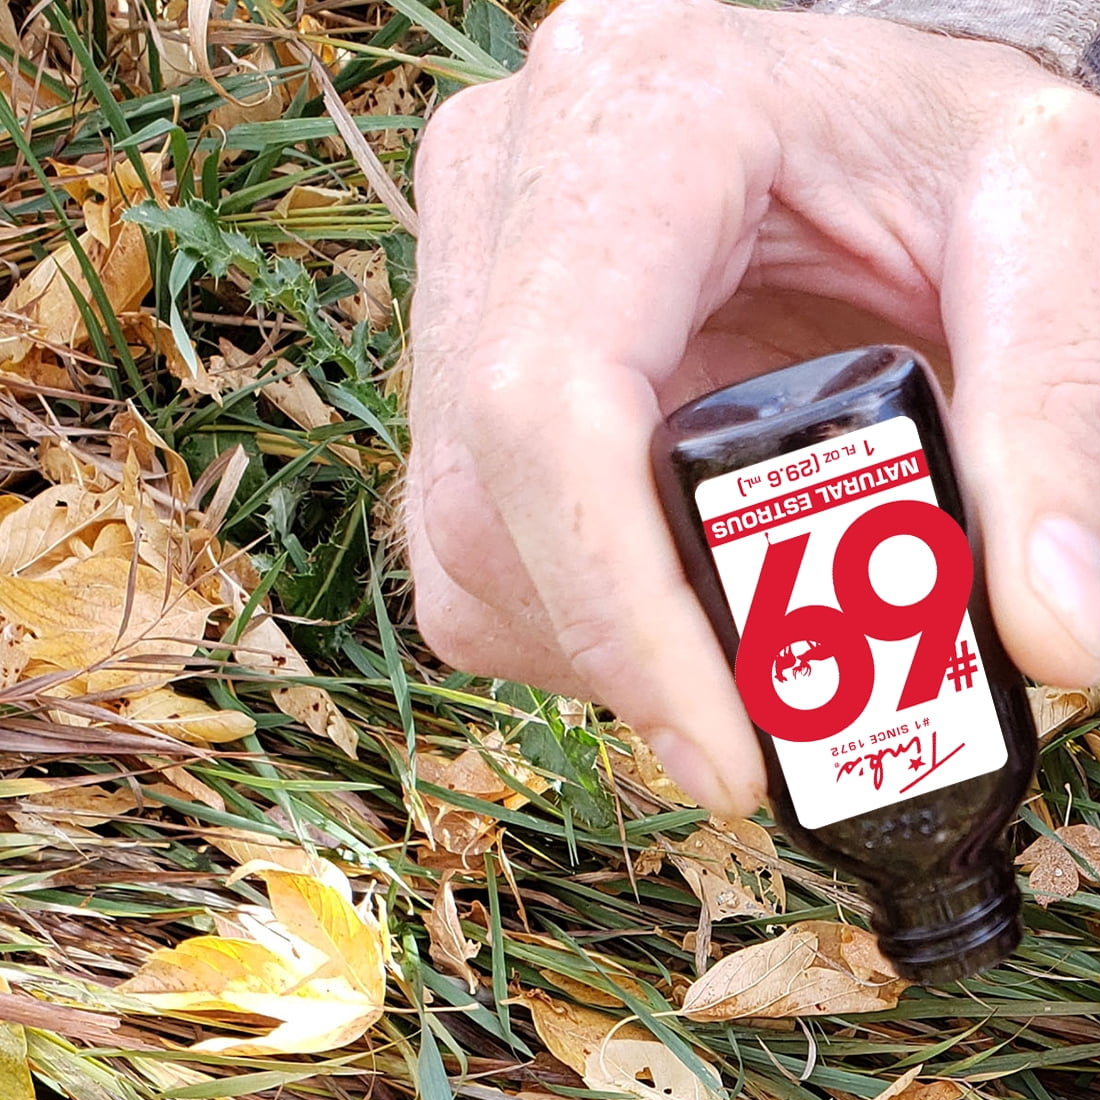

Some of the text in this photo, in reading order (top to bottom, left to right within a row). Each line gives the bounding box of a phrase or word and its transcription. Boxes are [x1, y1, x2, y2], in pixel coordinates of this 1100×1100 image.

[823, 449, 840, 464] OZ
[841, 444, 857, 457] FL
[863, 439, 876, 457] 1
[711, 456, 920, 539] NATURAL ESTROUS
[830, 717, 932, 757] #1 SINCE 1972
